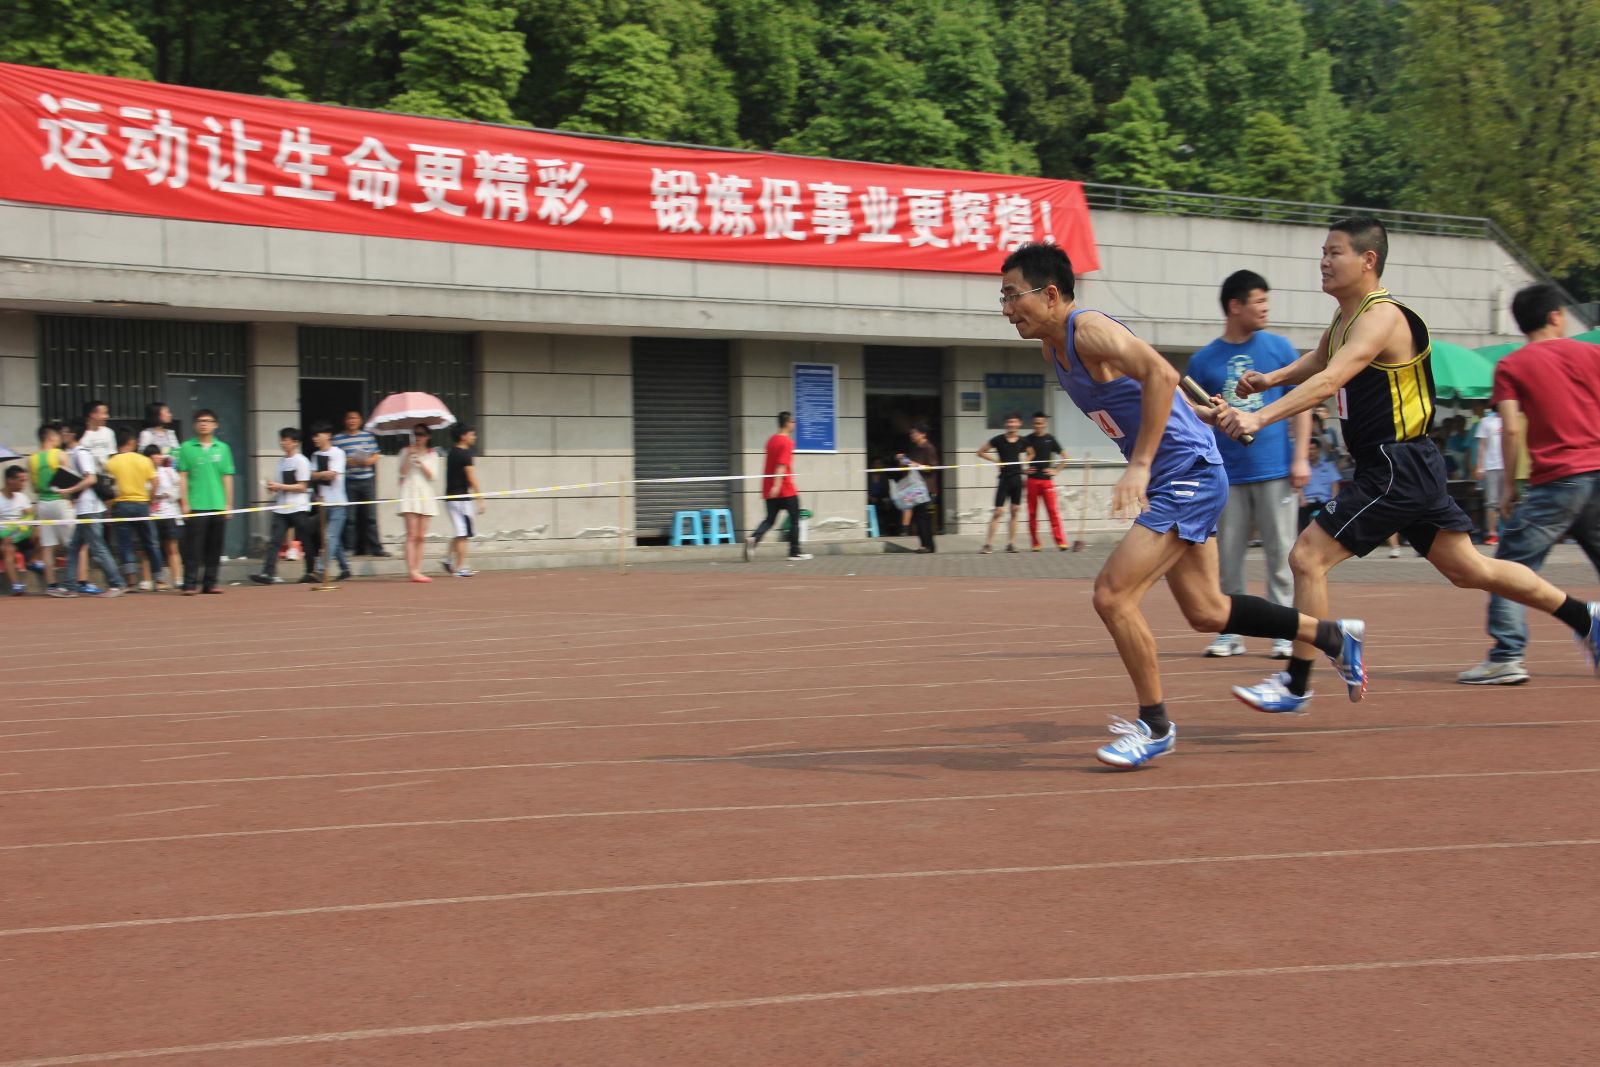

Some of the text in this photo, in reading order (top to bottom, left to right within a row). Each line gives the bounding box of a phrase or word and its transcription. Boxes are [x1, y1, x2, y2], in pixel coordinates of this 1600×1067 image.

[38, 93, 613, 226] 运动让生命更精彩，
[1098, 412, 1117, 437] 4
